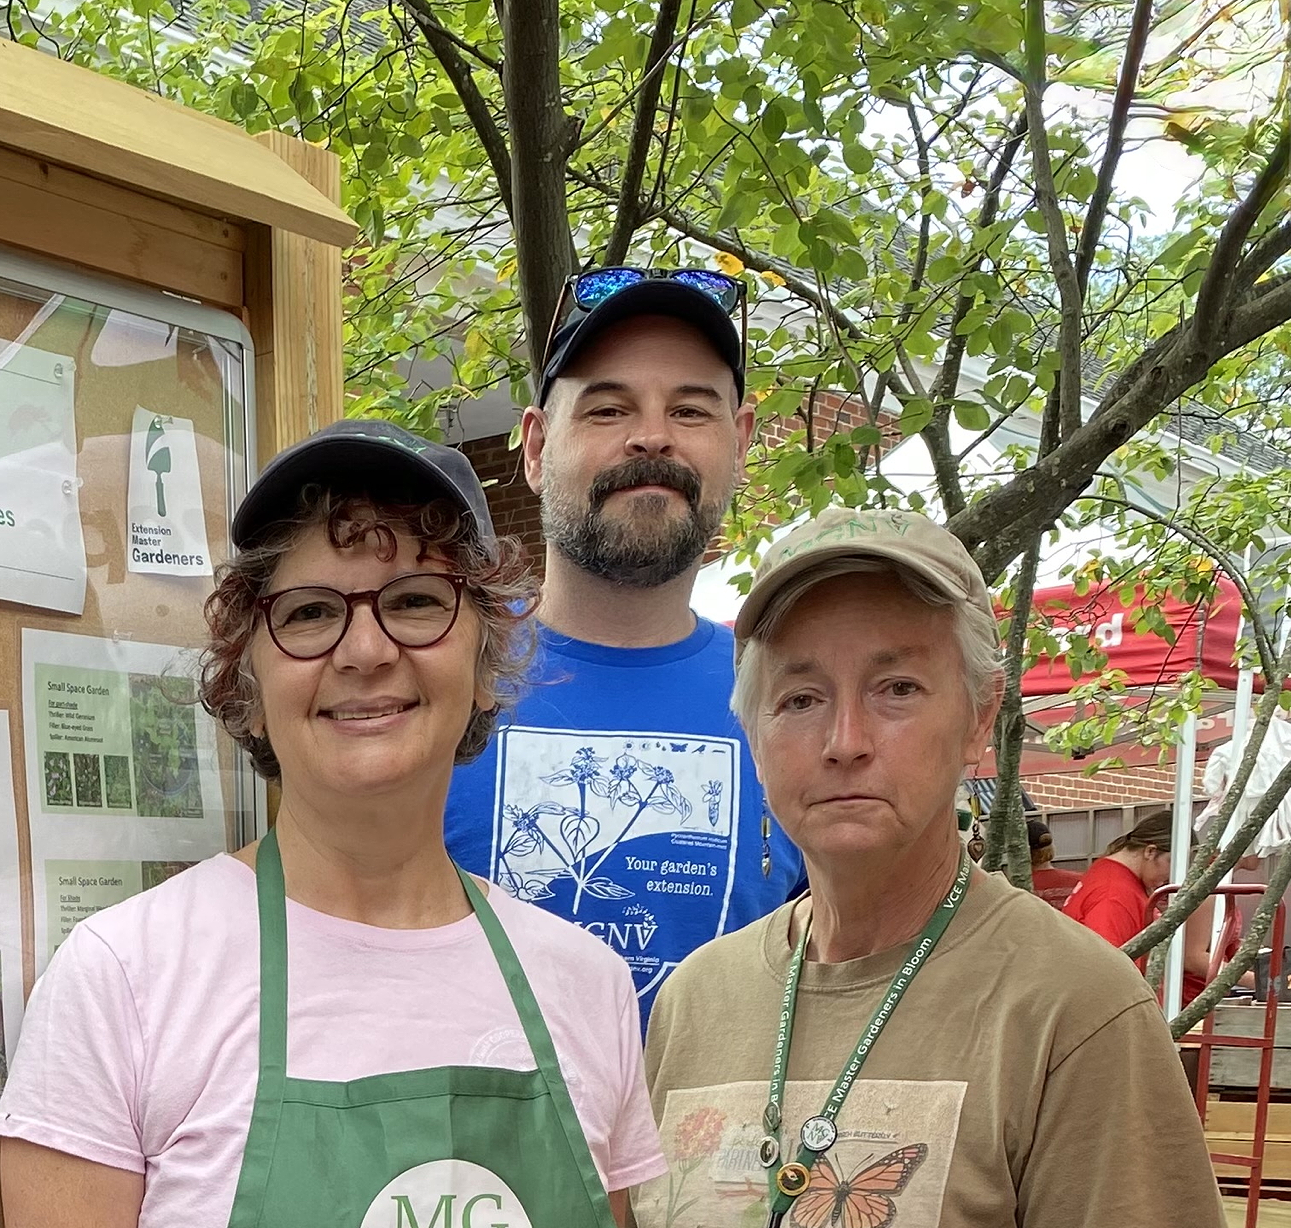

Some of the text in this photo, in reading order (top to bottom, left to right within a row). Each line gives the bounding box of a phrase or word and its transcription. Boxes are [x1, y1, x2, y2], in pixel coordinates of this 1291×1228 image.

[132, 523, 171, 535] Extension
[132, 535, 161, 546] Master
[132, 548, 203, 565] Gardeners
[48, 681, 109, 695] Small Space Garden
[625, 857, 717, 876] Your garden's
[59, 876, 122, 887] Small Space Garden
[647, 880, 713, 895] extension.
[943, 884, 963, 908] VCE
[771, 965, 798, 1091] Master Gardeners in
[832, 1057, 860, 1106] Master
[858, 991, 899, 1055] Gardeners
[895, 977, 907, 992] in
[902, 937, 932, 976] Bloom
